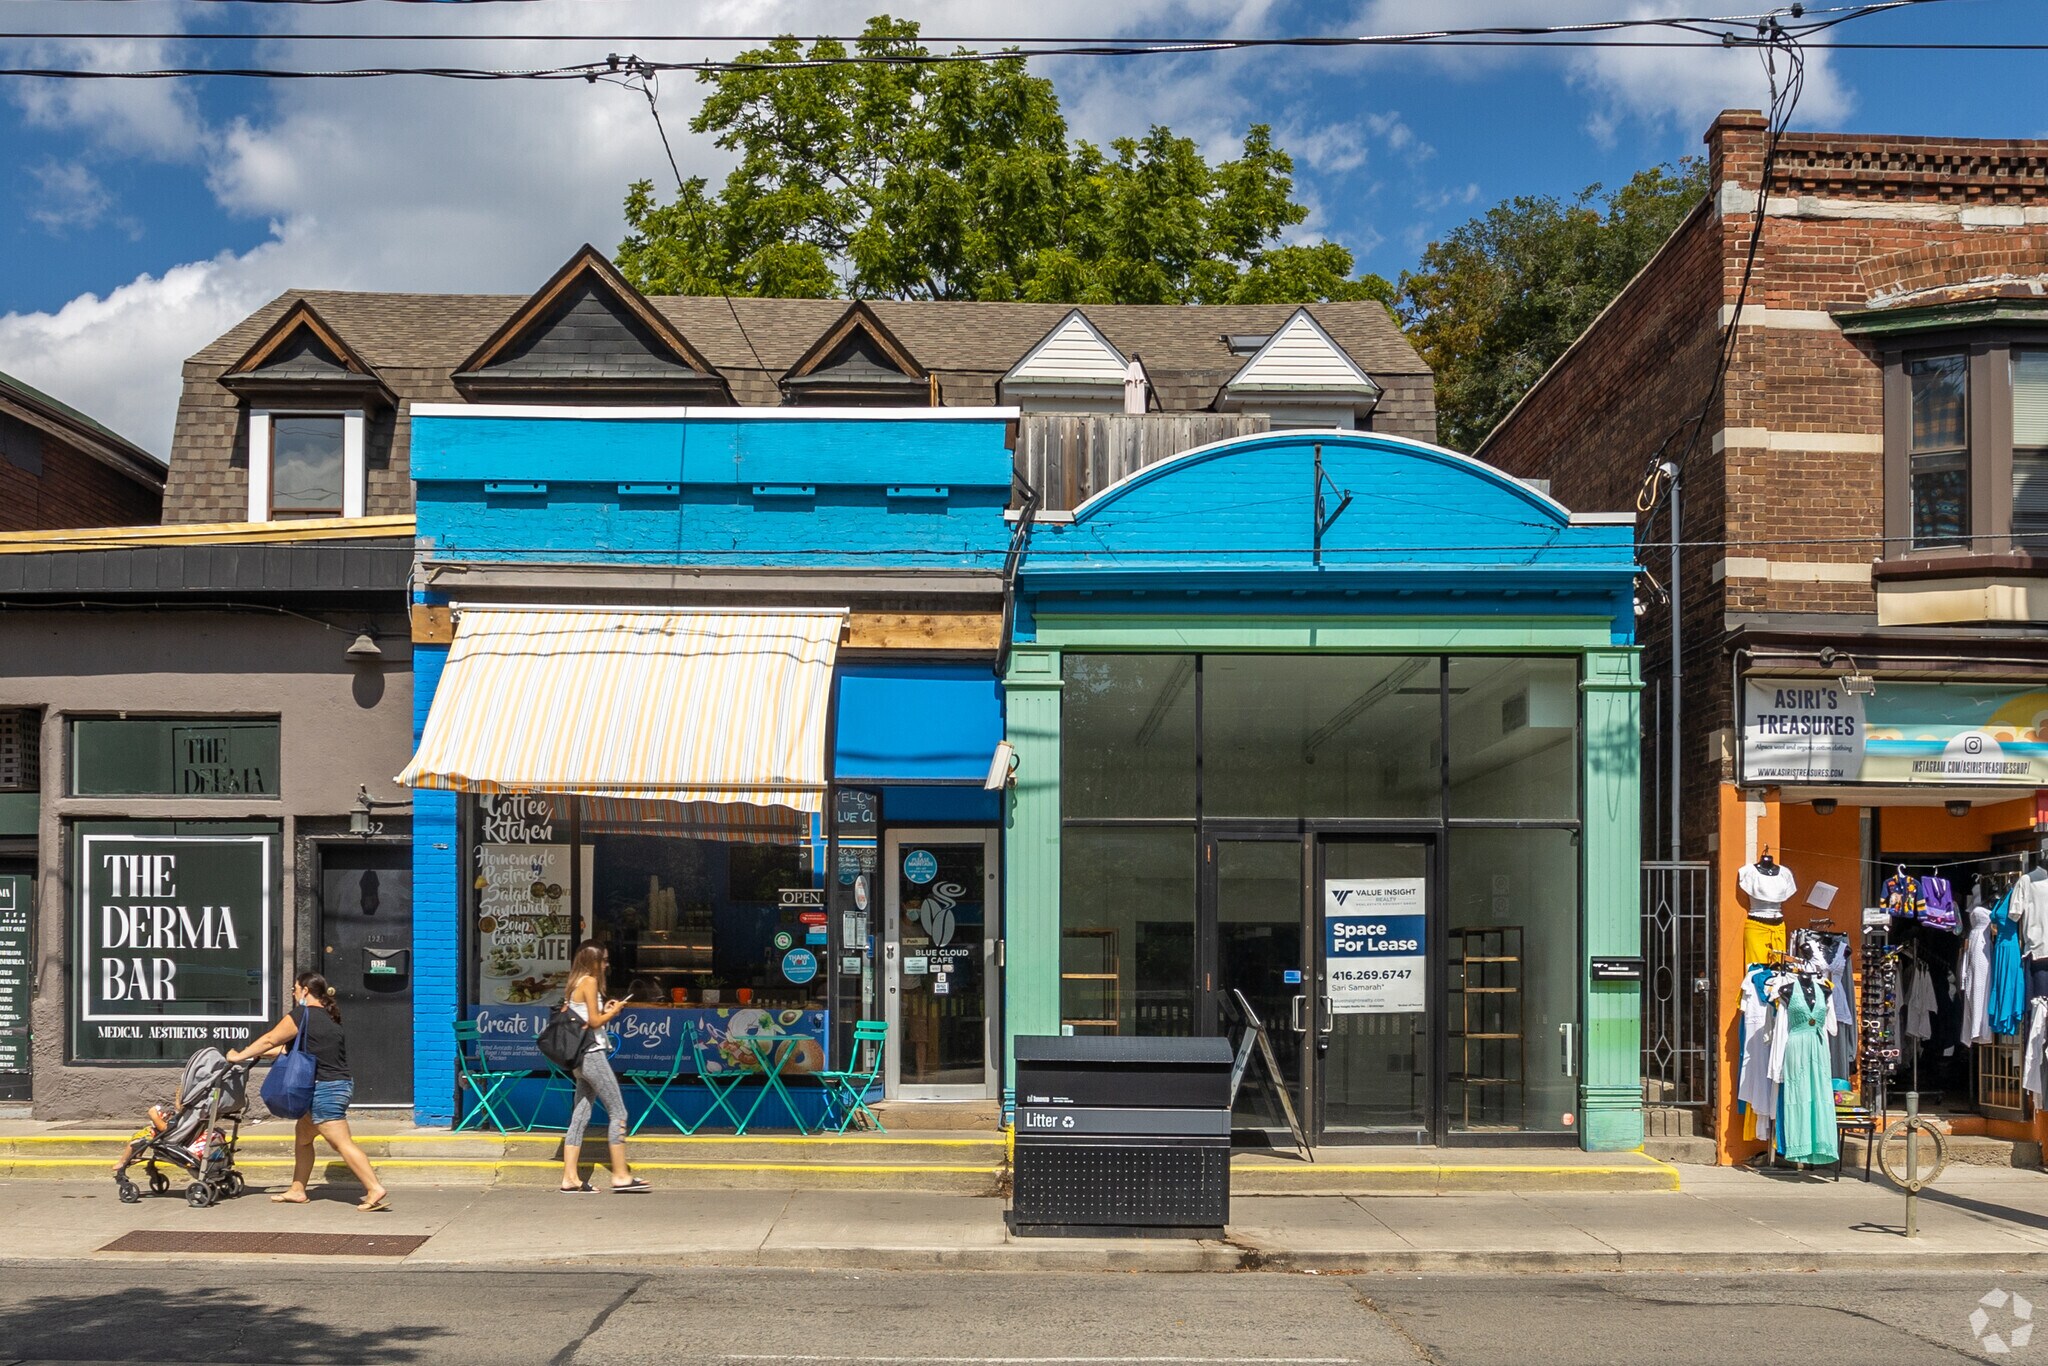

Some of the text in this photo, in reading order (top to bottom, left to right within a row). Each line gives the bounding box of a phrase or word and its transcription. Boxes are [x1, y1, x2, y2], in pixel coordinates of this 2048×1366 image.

[1775, 688, 1838, 710] ASIRI'S
[1757, 715, 1855, 736] TREASURES
[1755, 743, 1773, 751] Alpaca
[1832, 744, 1853, 753] clothing
[1757, 768, 1844, 777] WWW.ASIRISTREASURES.COM
[482, 816, 553, 845] Kitchen
[473, 845, 556, 868] Homemade
[103, 854, 176, 898] THE
[482, 865, 539, 884] Pastries
[488, 882, 533, 902] Salad
[782, 891, 821, 904] OPEN
[1384, 888, 1416, 896] INSIGHT
[479, 898, 551, 917] Sandwich
[101, 905, 239, 949] DERMA
[497, 915, 530, 934] Soup
[1333, 922, 1387, 939] Space
[491, 931, 535, 947] Cookies
[1334, 938, 1418, 952] For Lease
[101, 957, 177, 1001] BAR
[1332, 969, 1412, 981] 416.269.6747
[1332, 984, 1347, 992] Sari
[98, 1026, 250, 1040] MEDICAL AESTHETICS STUDIO
[475, 1011, 529, 1034] Create
[623, 1014, 671, 1048] Bagel
[1026, 1112, 1058, 1128] Litter
